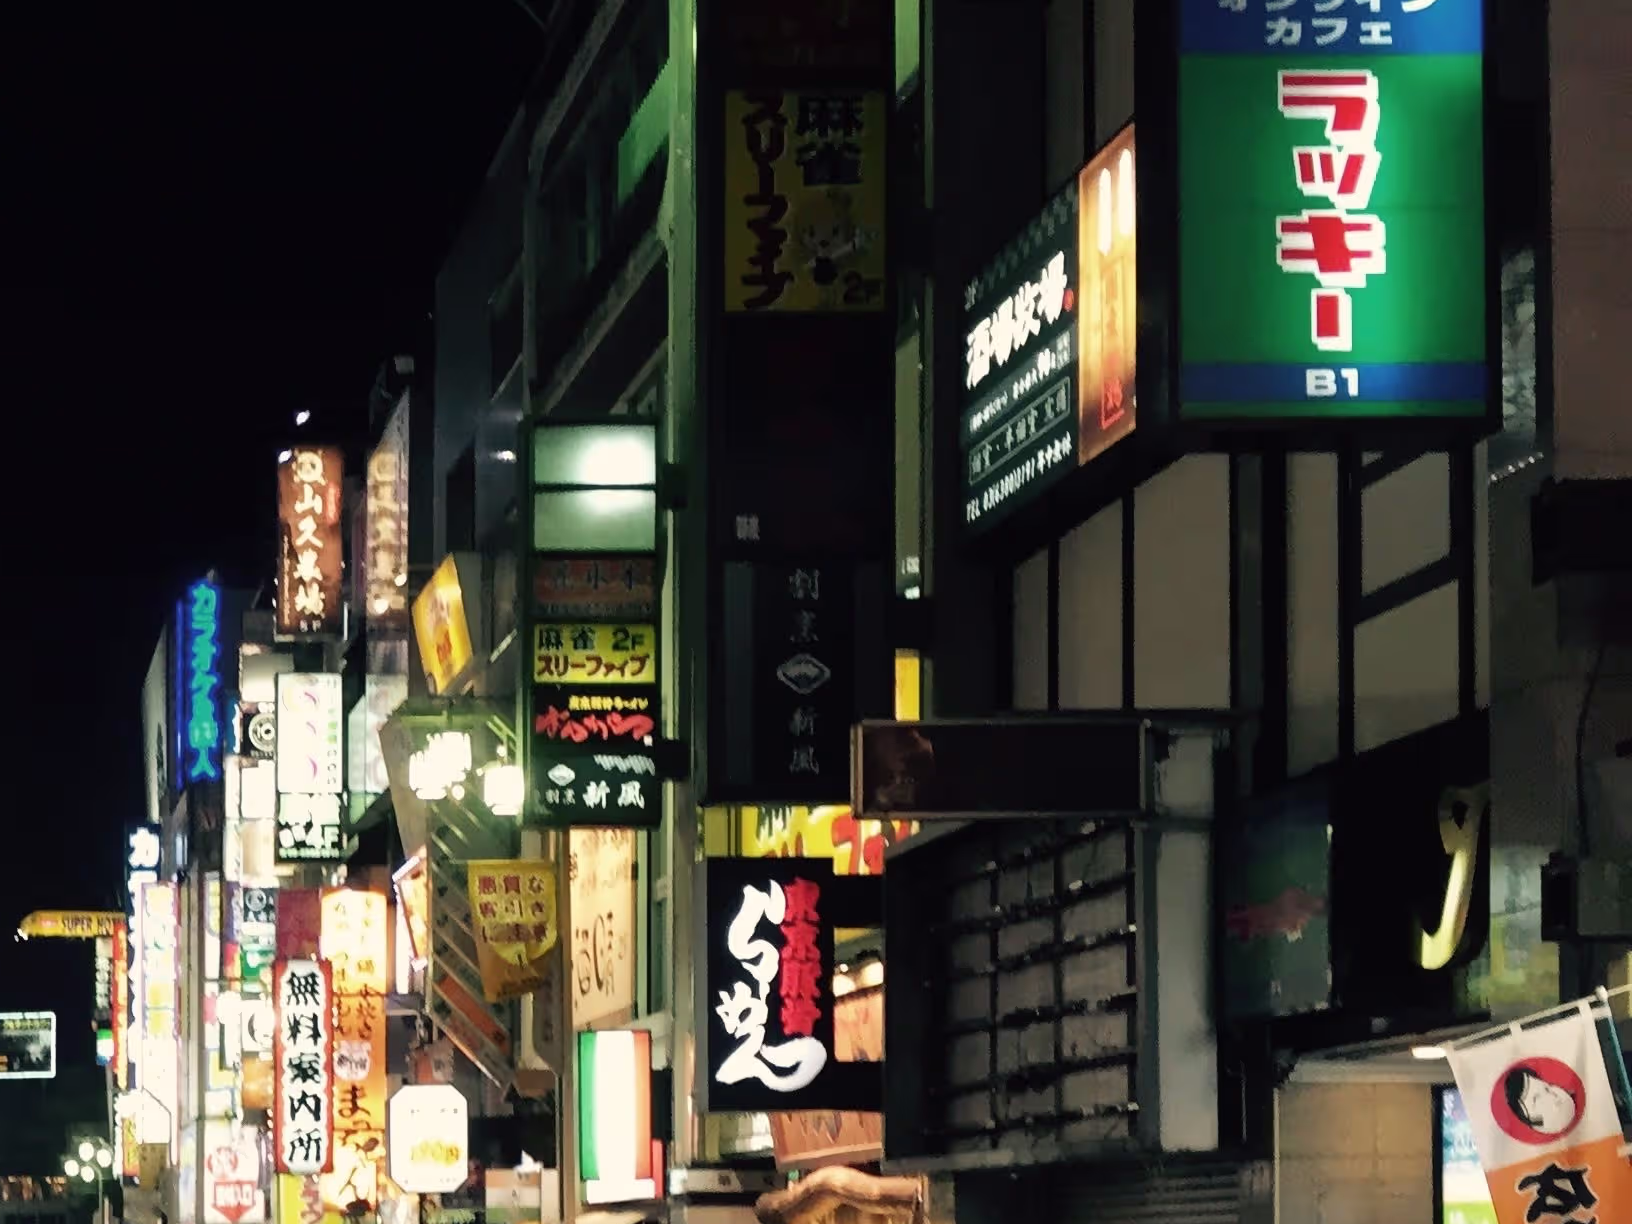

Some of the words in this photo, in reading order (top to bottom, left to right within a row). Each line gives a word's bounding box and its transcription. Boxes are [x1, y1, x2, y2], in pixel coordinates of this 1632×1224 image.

[1266, 17, 1394, 46] カフェ
[1276, 69, 1387, 352] ラッキー
[1305, 368, 1360, 397] B1
[538, 627, 595, 652] 麻雀
[612, 628, 645, 651] 2F
[286, 970, 322, 1166] 無料案内所
